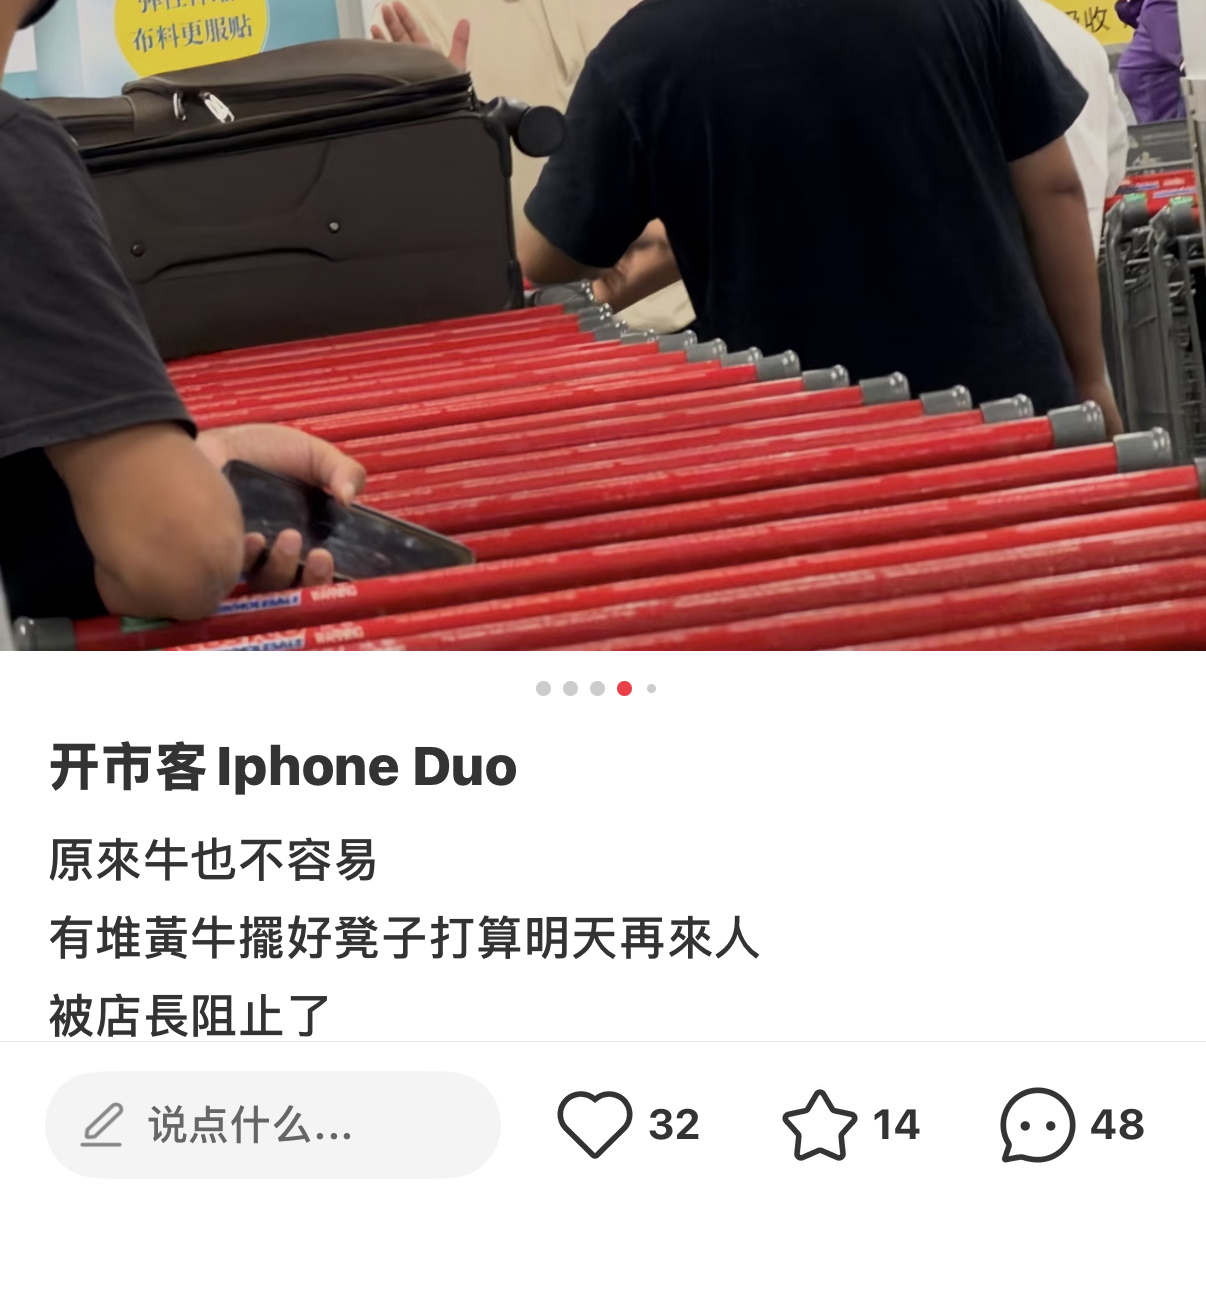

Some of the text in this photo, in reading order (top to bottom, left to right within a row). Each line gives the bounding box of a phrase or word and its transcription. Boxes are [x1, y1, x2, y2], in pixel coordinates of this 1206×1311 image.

[130, 13, 253, 53] 布料更服贴
